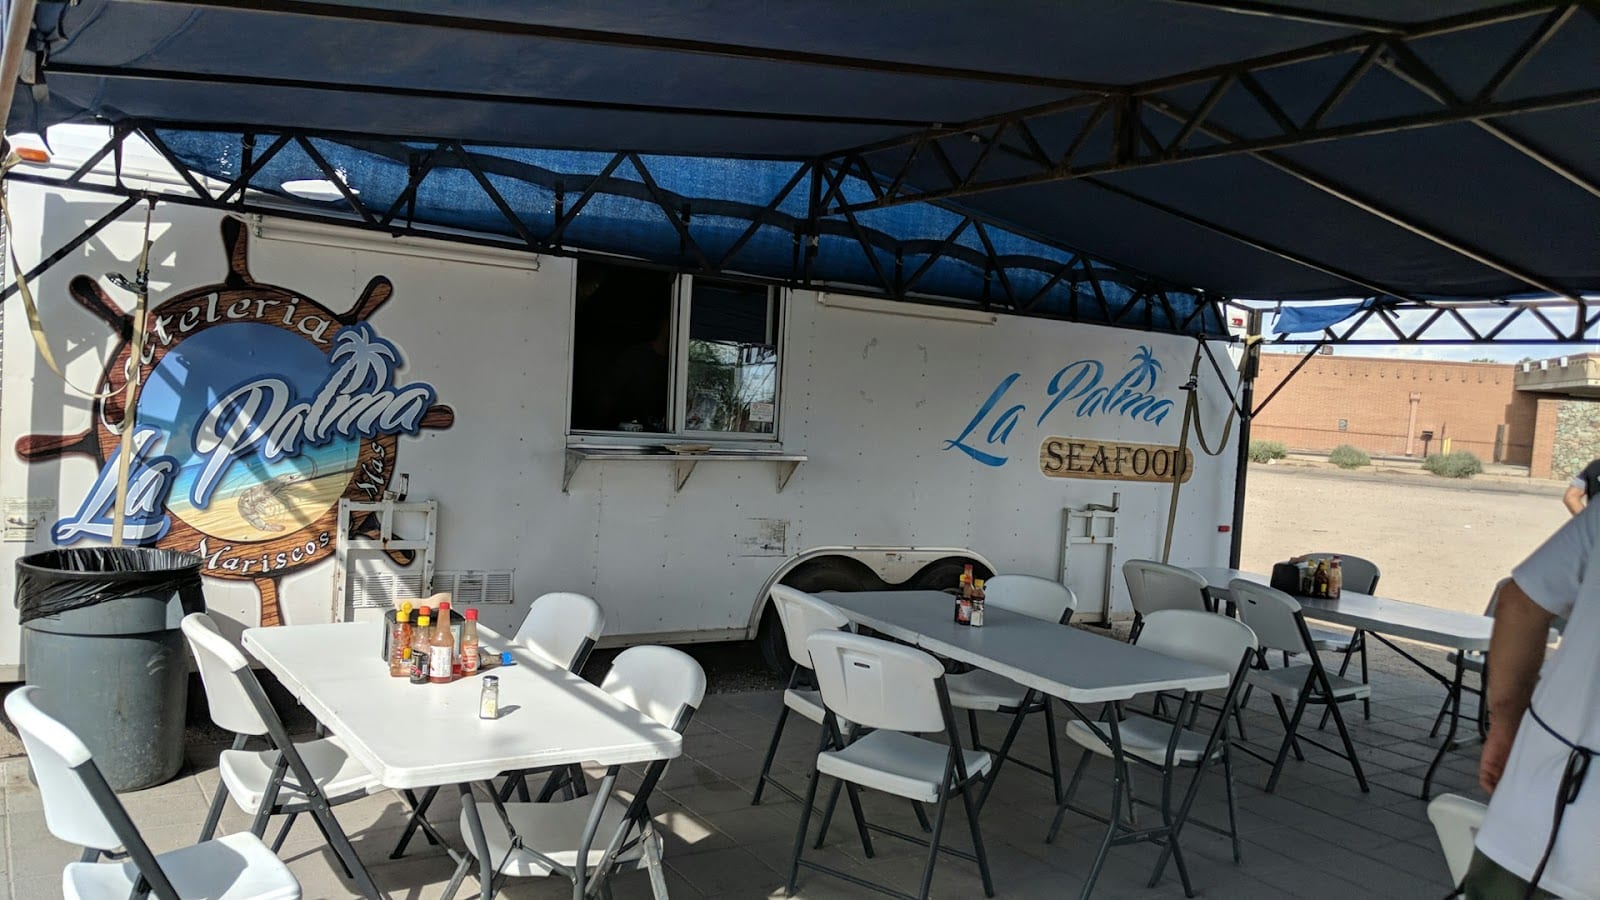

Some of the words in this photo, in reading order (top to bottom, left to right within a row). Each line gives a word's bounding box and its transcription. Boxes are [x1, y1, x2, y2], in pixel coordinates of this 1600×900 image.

[54, 428, 175, 541] La
[193, 326, 431, 506] Palma
[942, 372, 1027, 466] La
[1037, 345, 1175, 428] Palma
[1044, 441, 1188, 477] SEAFOOD
[189, 532, 330, 574] Mariscos
